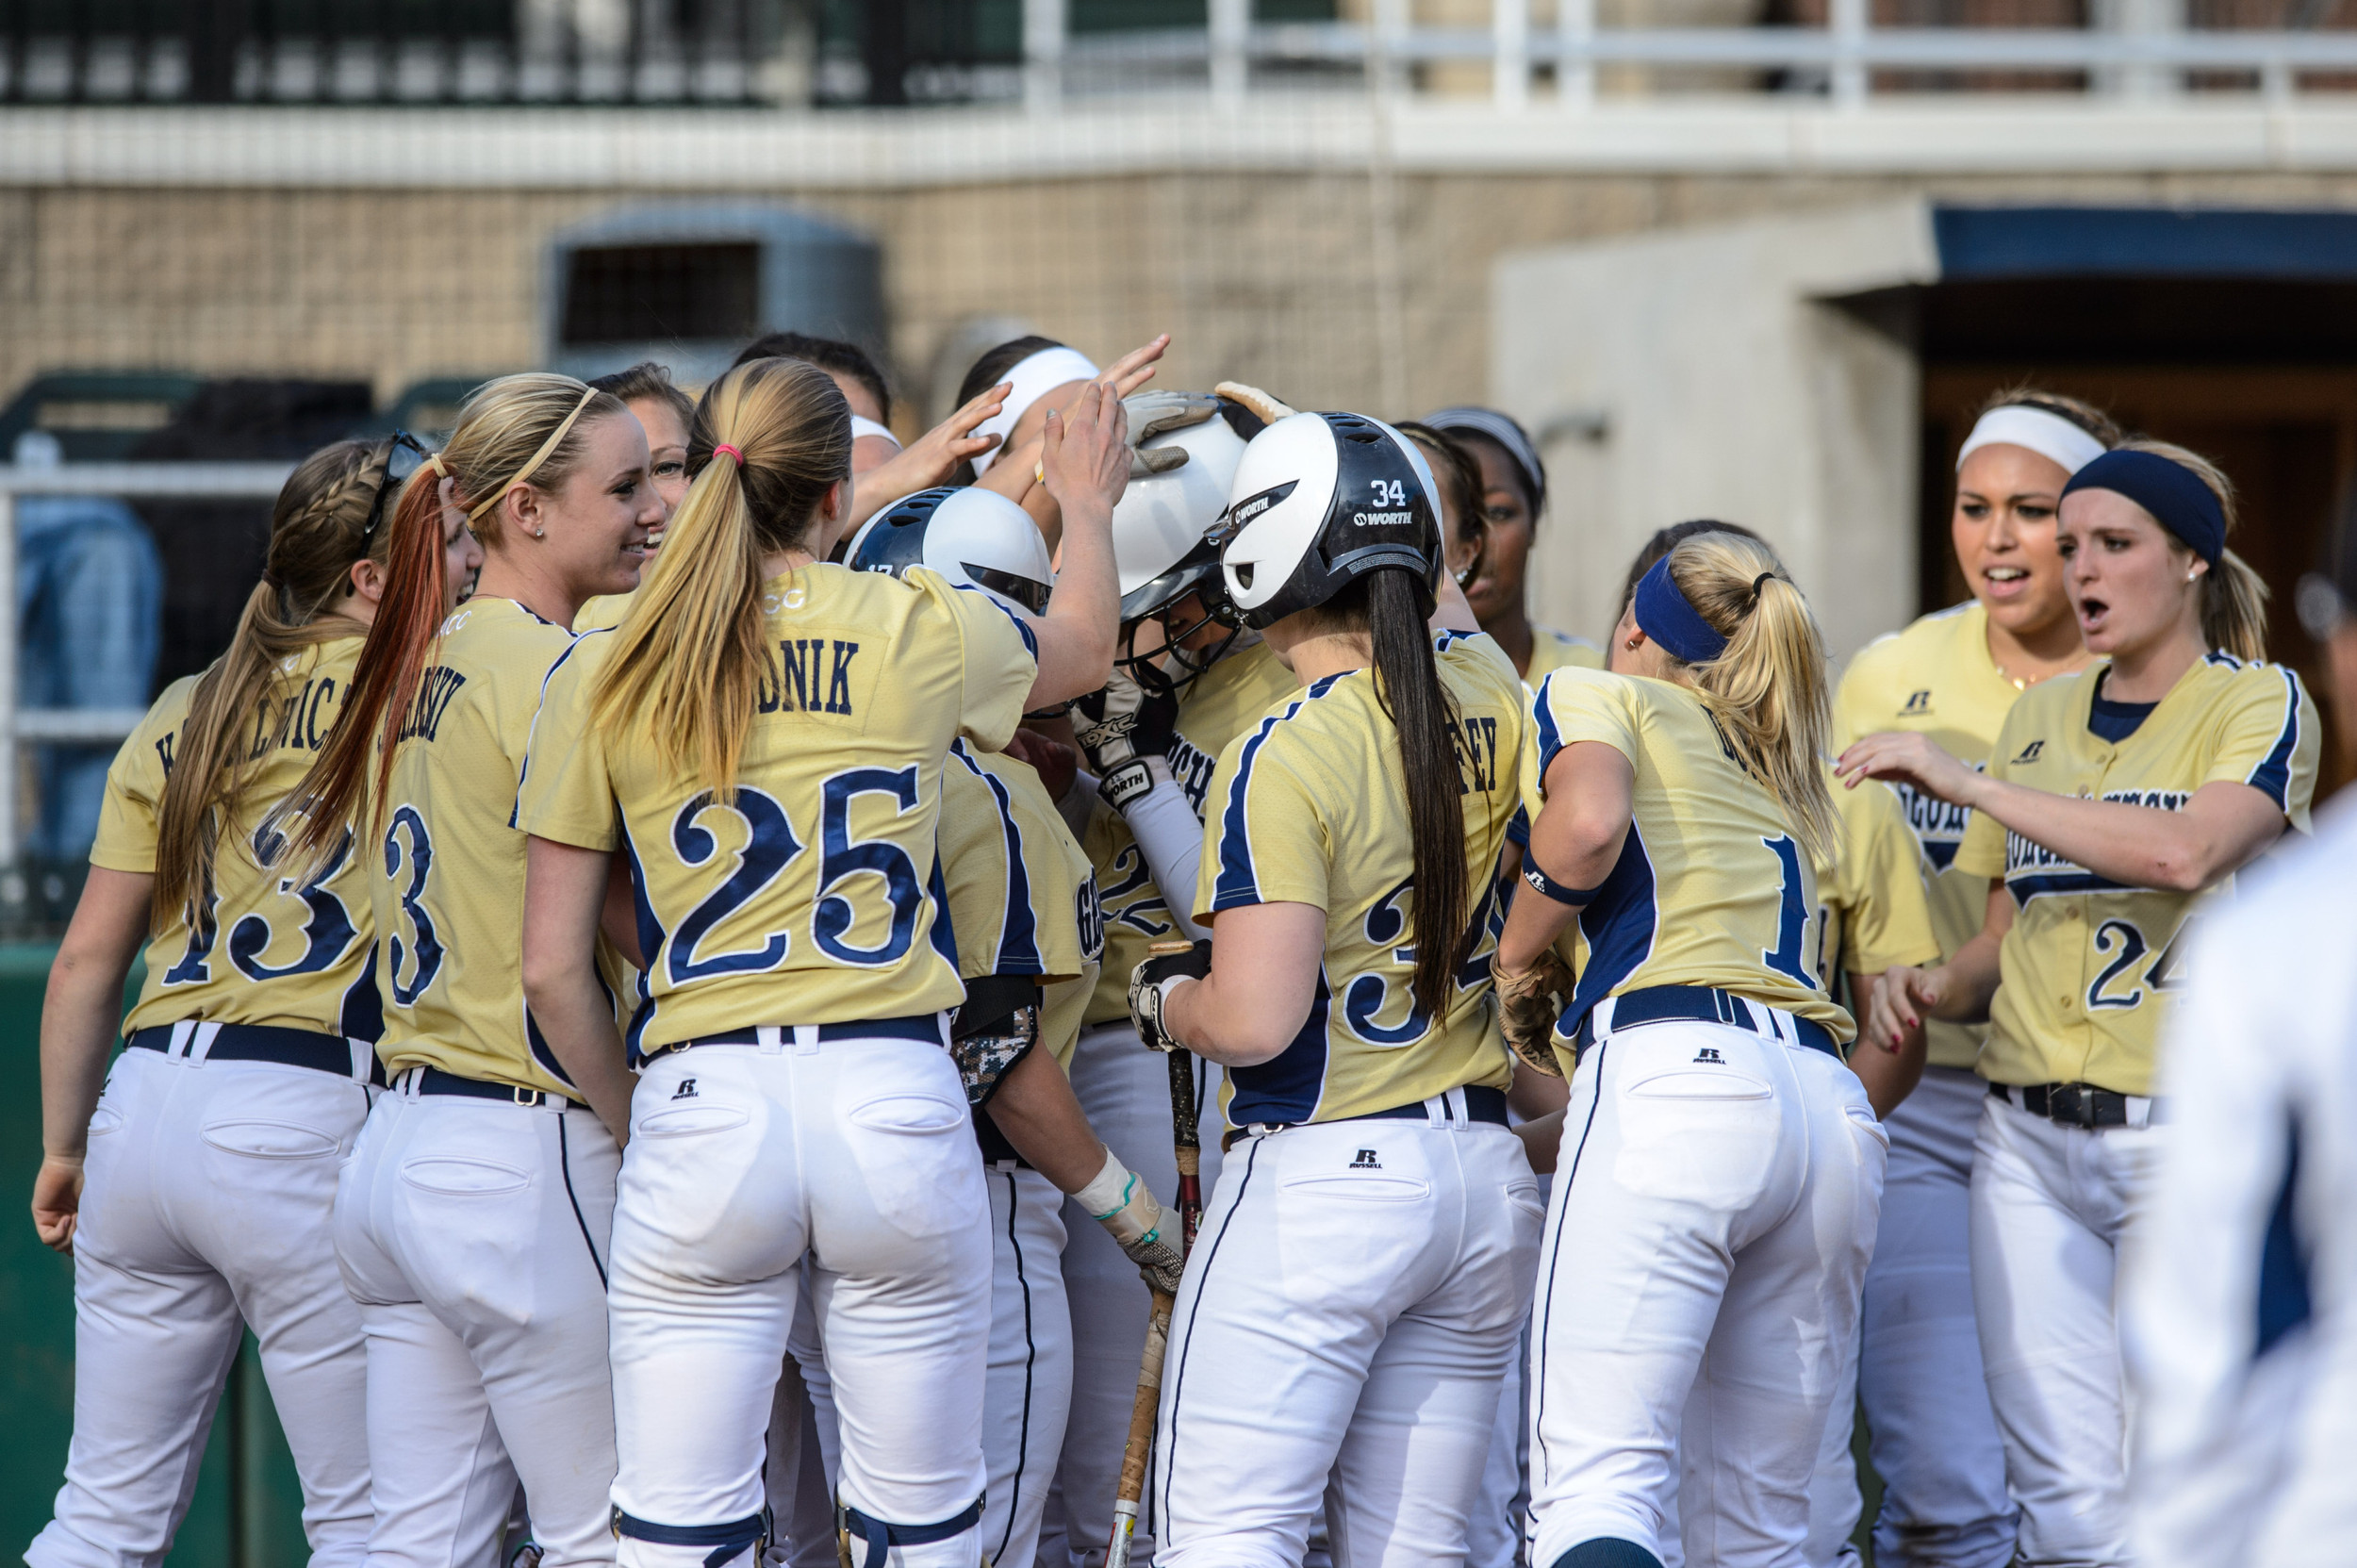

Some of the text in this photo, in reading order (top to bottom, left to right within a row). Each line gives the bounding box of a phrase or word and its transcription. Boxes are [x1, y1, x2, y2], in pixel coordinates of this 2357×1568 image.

[1240, 496, 1269, 520] WORTH
[1367, 511, 1412, 526] WORTH
[1370, 479, 1406, 507] 34
[757, 638, 859, 717] DNIK
[161, 794, 361, 987] 13
[384, 803, 448, 1009] 3
[662, 763, 926, 988] 25
[1759, 830, 1818, 991] 1
